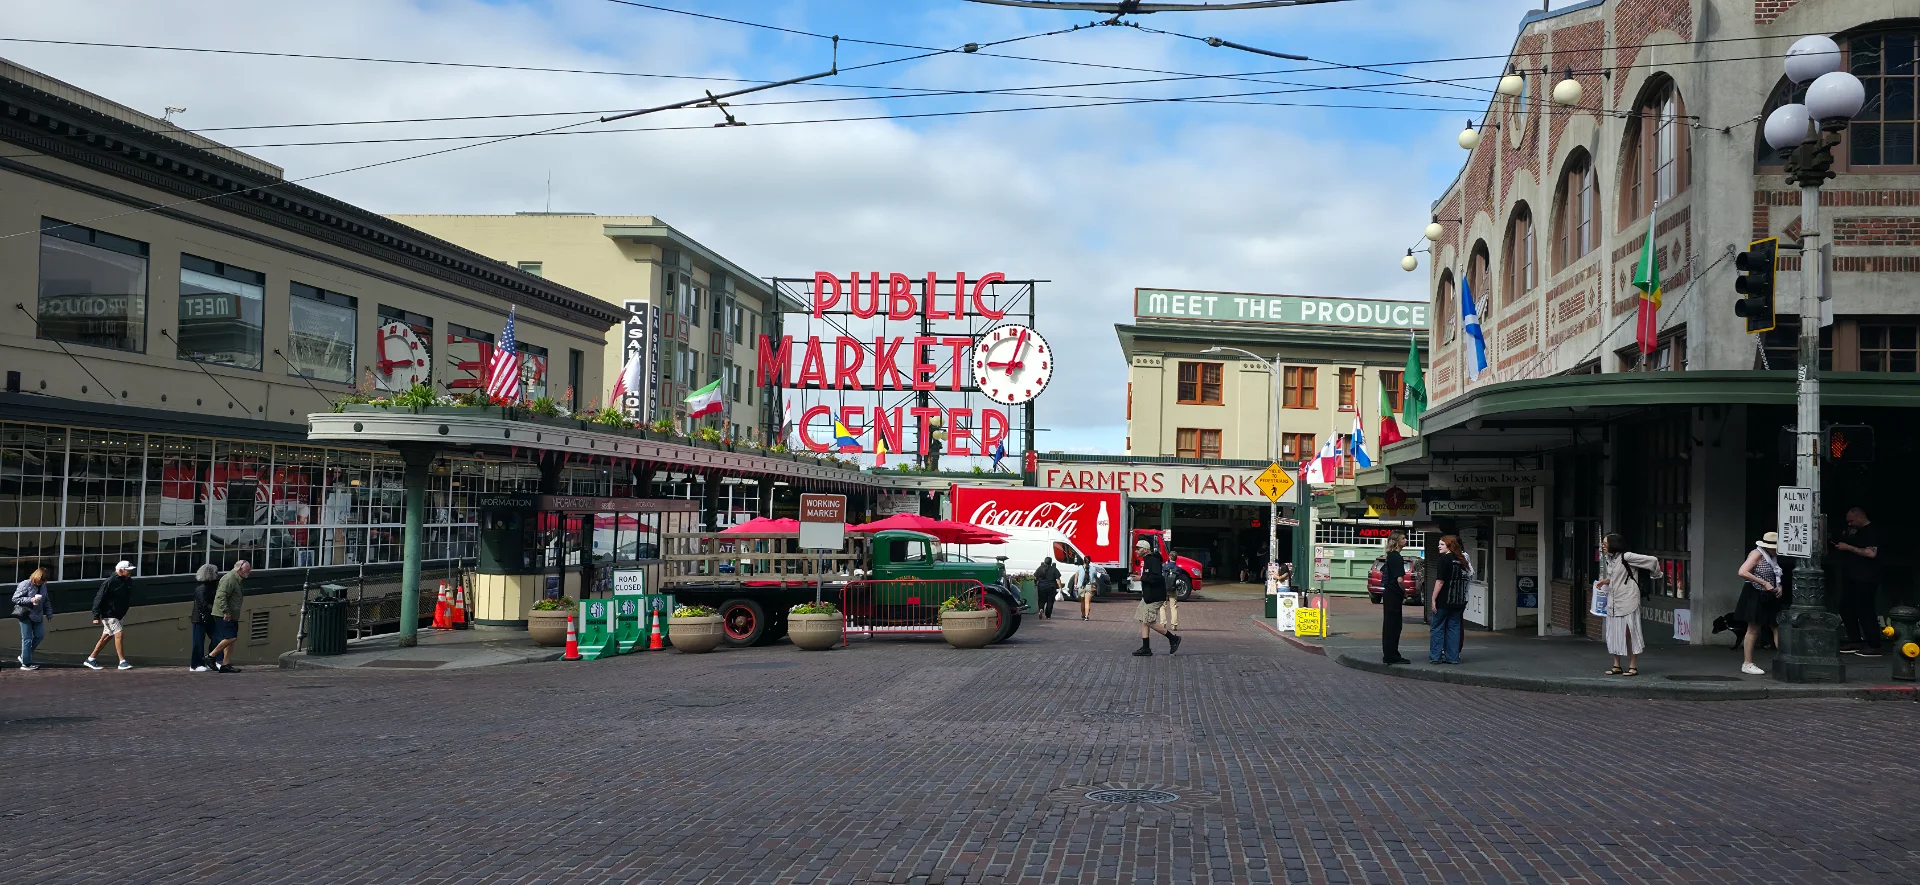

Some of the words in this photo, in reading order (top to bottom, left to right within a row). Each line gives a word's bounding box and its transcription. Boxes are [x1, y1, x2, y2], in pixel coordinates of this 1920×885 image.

[814, 271, 1005, 320] PUBLIC
[1150, 293, 1218, 316] MEET
[1234, 298, 1282, 319] THE
[1301, 301, 1430, 326] PRODUCE
[994, 332, 1000, 341] 11
[1009, 328, 1018, 337] 12
[1028, 332, 1032, 341] 1
[981, 344, 989, 353] 10
[1038, 345, 1044, 353] 2
[650, 333, 659, 384] SALLE
[757, 334, 974, 391] MARKET
[976, 360, 983, 368] 9
[1042, 361, 1048, 370] 3
[980, 376, 987, 385] 8
[1036, 377, 1043, 386] 4
[992, 389, 998, 397] 7
[1008, 393, 1014, 402] 6
[1025, 389, 1031, 397] 5
[648, 388, 657, 424] HOT
[798, 405, 1010, 457] CENTER
[1047, 469, 1165, 493] FARMERS
[1181, 473, 1264, 496] MARK
[1502, 473, 1537, 484] books
[1784, 492, 1797, 501] ALL
[806, 499, 841, 509] WORKING
[1432, 501, 1447, 510] The
[1448, 501, 1477, 512] Crumpet
[1480, 501, 1500, 511] Shop
[1789, 503, 1805, 511] WALK
[806, 509, 839, 518] MARKET
[969, 500, 1084, 538] Coca-Cola
